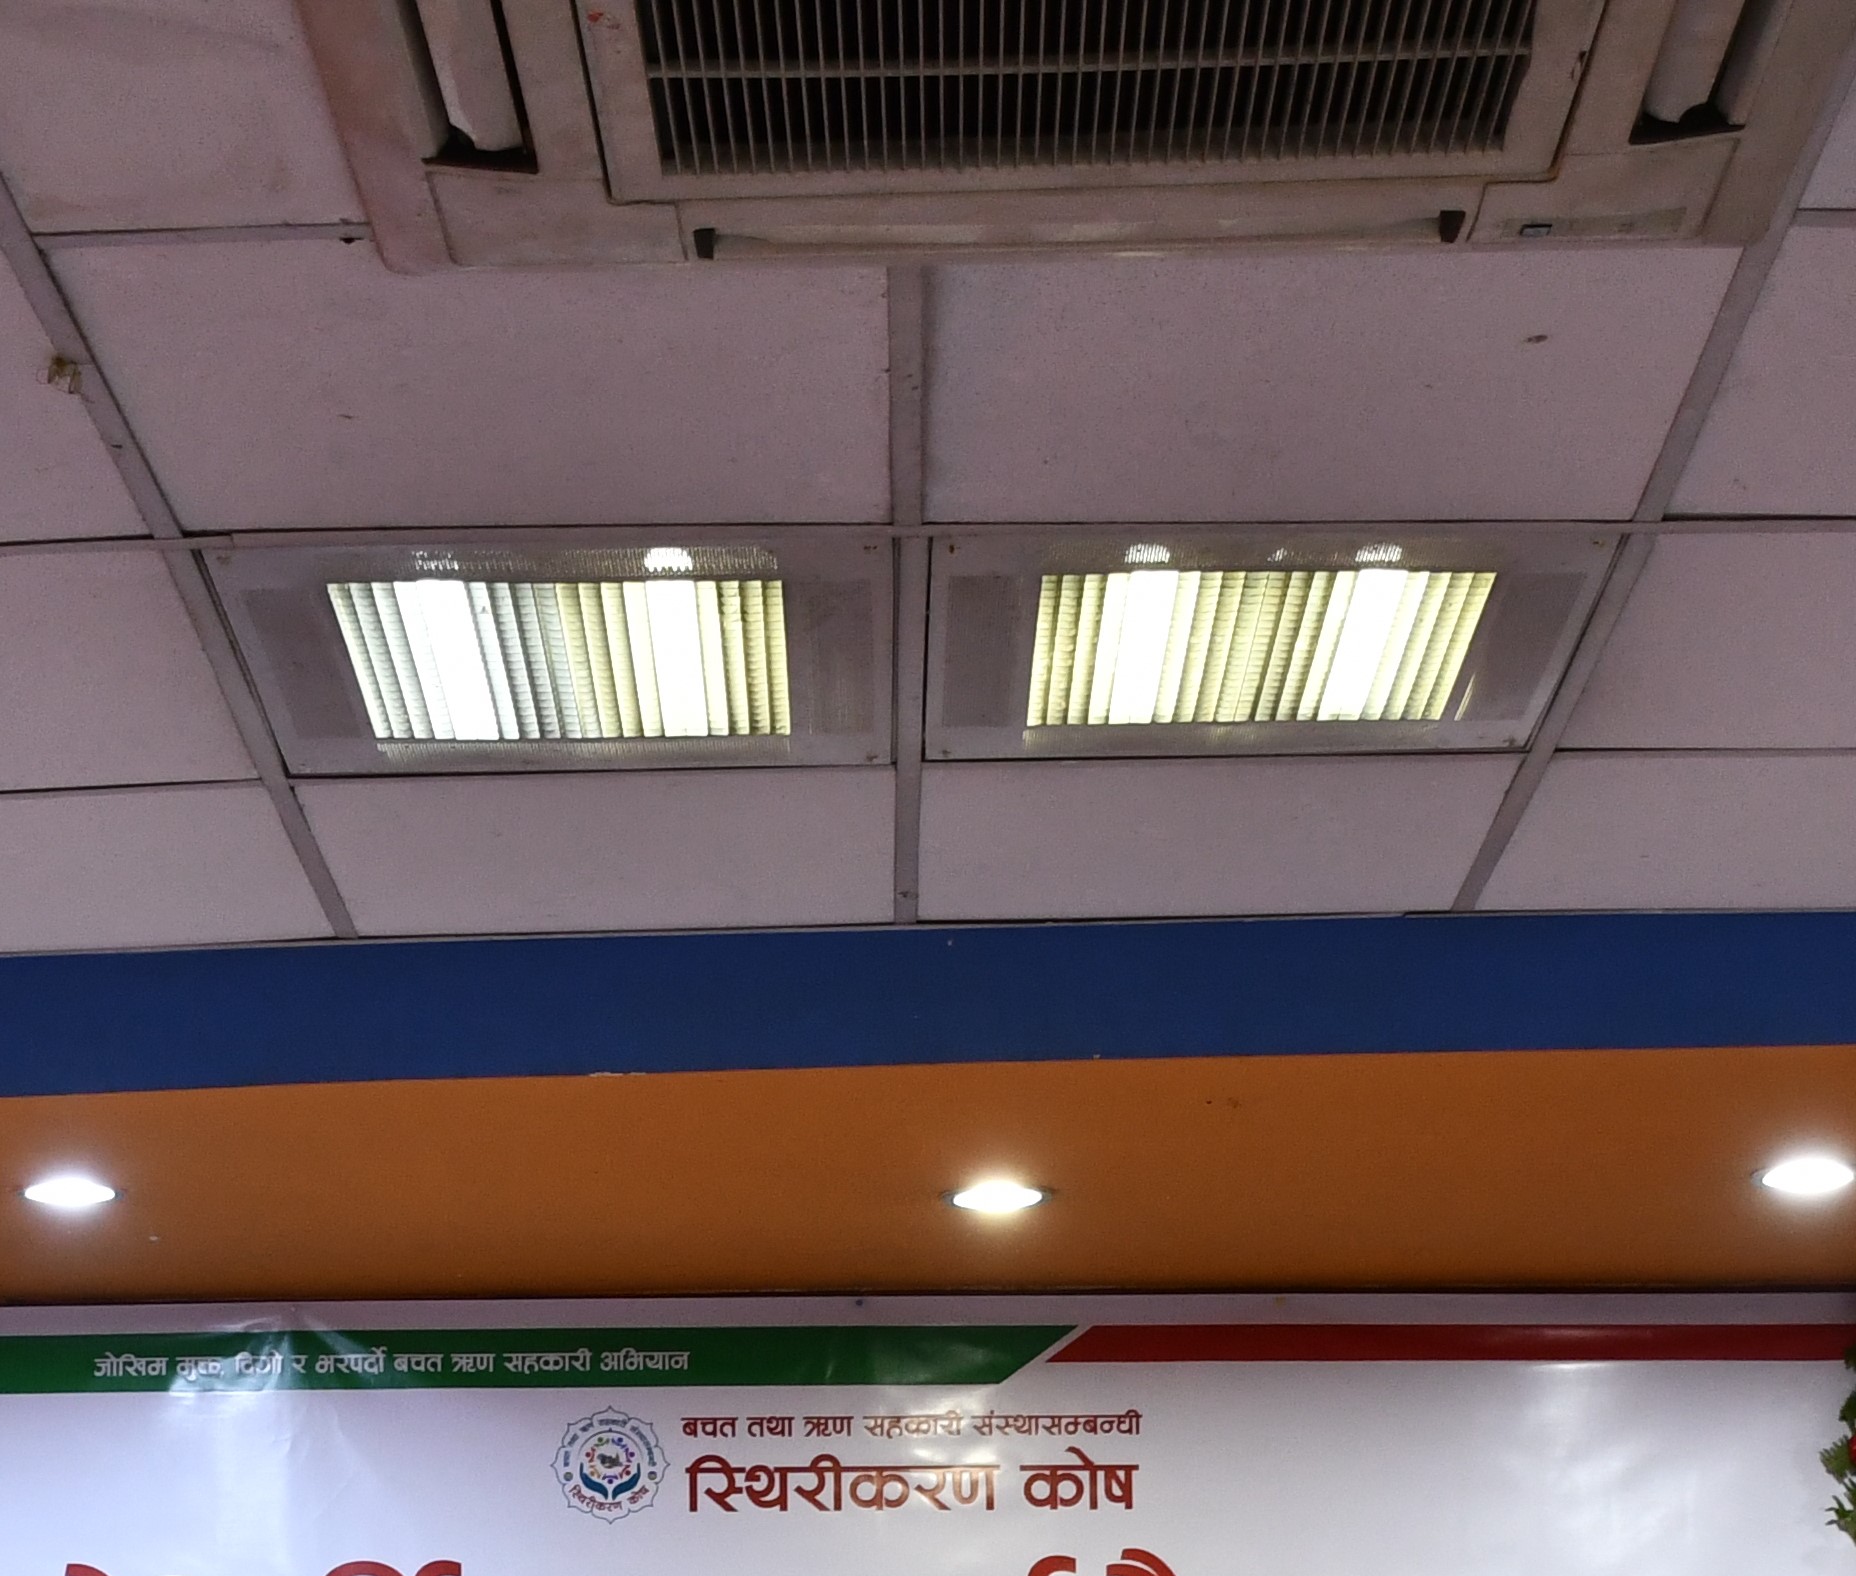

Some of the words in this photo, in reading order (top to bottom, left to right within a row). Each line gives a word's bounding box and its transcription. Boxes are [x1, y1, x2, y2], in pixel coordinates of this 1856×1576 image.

[94, 1352, 168, 1376] जोखिम
[293, 1354, 307, 1373] र
[314, 1346, 388, 1375] भरपर्दो
[393, 1353, 443, 1373] बचत
[451, 1353, 495, 1373] ऋण
[503, 1348, 592, 1375] सहकारी
[599, 1348, 690, 1372] अभियान
[681, 1416, 738, 1438] बचत
[746, 1416, 795, 1438] तथा
[803, 1416, 854, 1437] ऋण
[863, 1409, 962, 1439] सहकारी
[971, 1409, 1143, 1437] संस्थासम्बन्धी
[685, 1454, 1001, 1512] स्थिरीकरण
[1019, 1446, 1139, 1511] कोष
